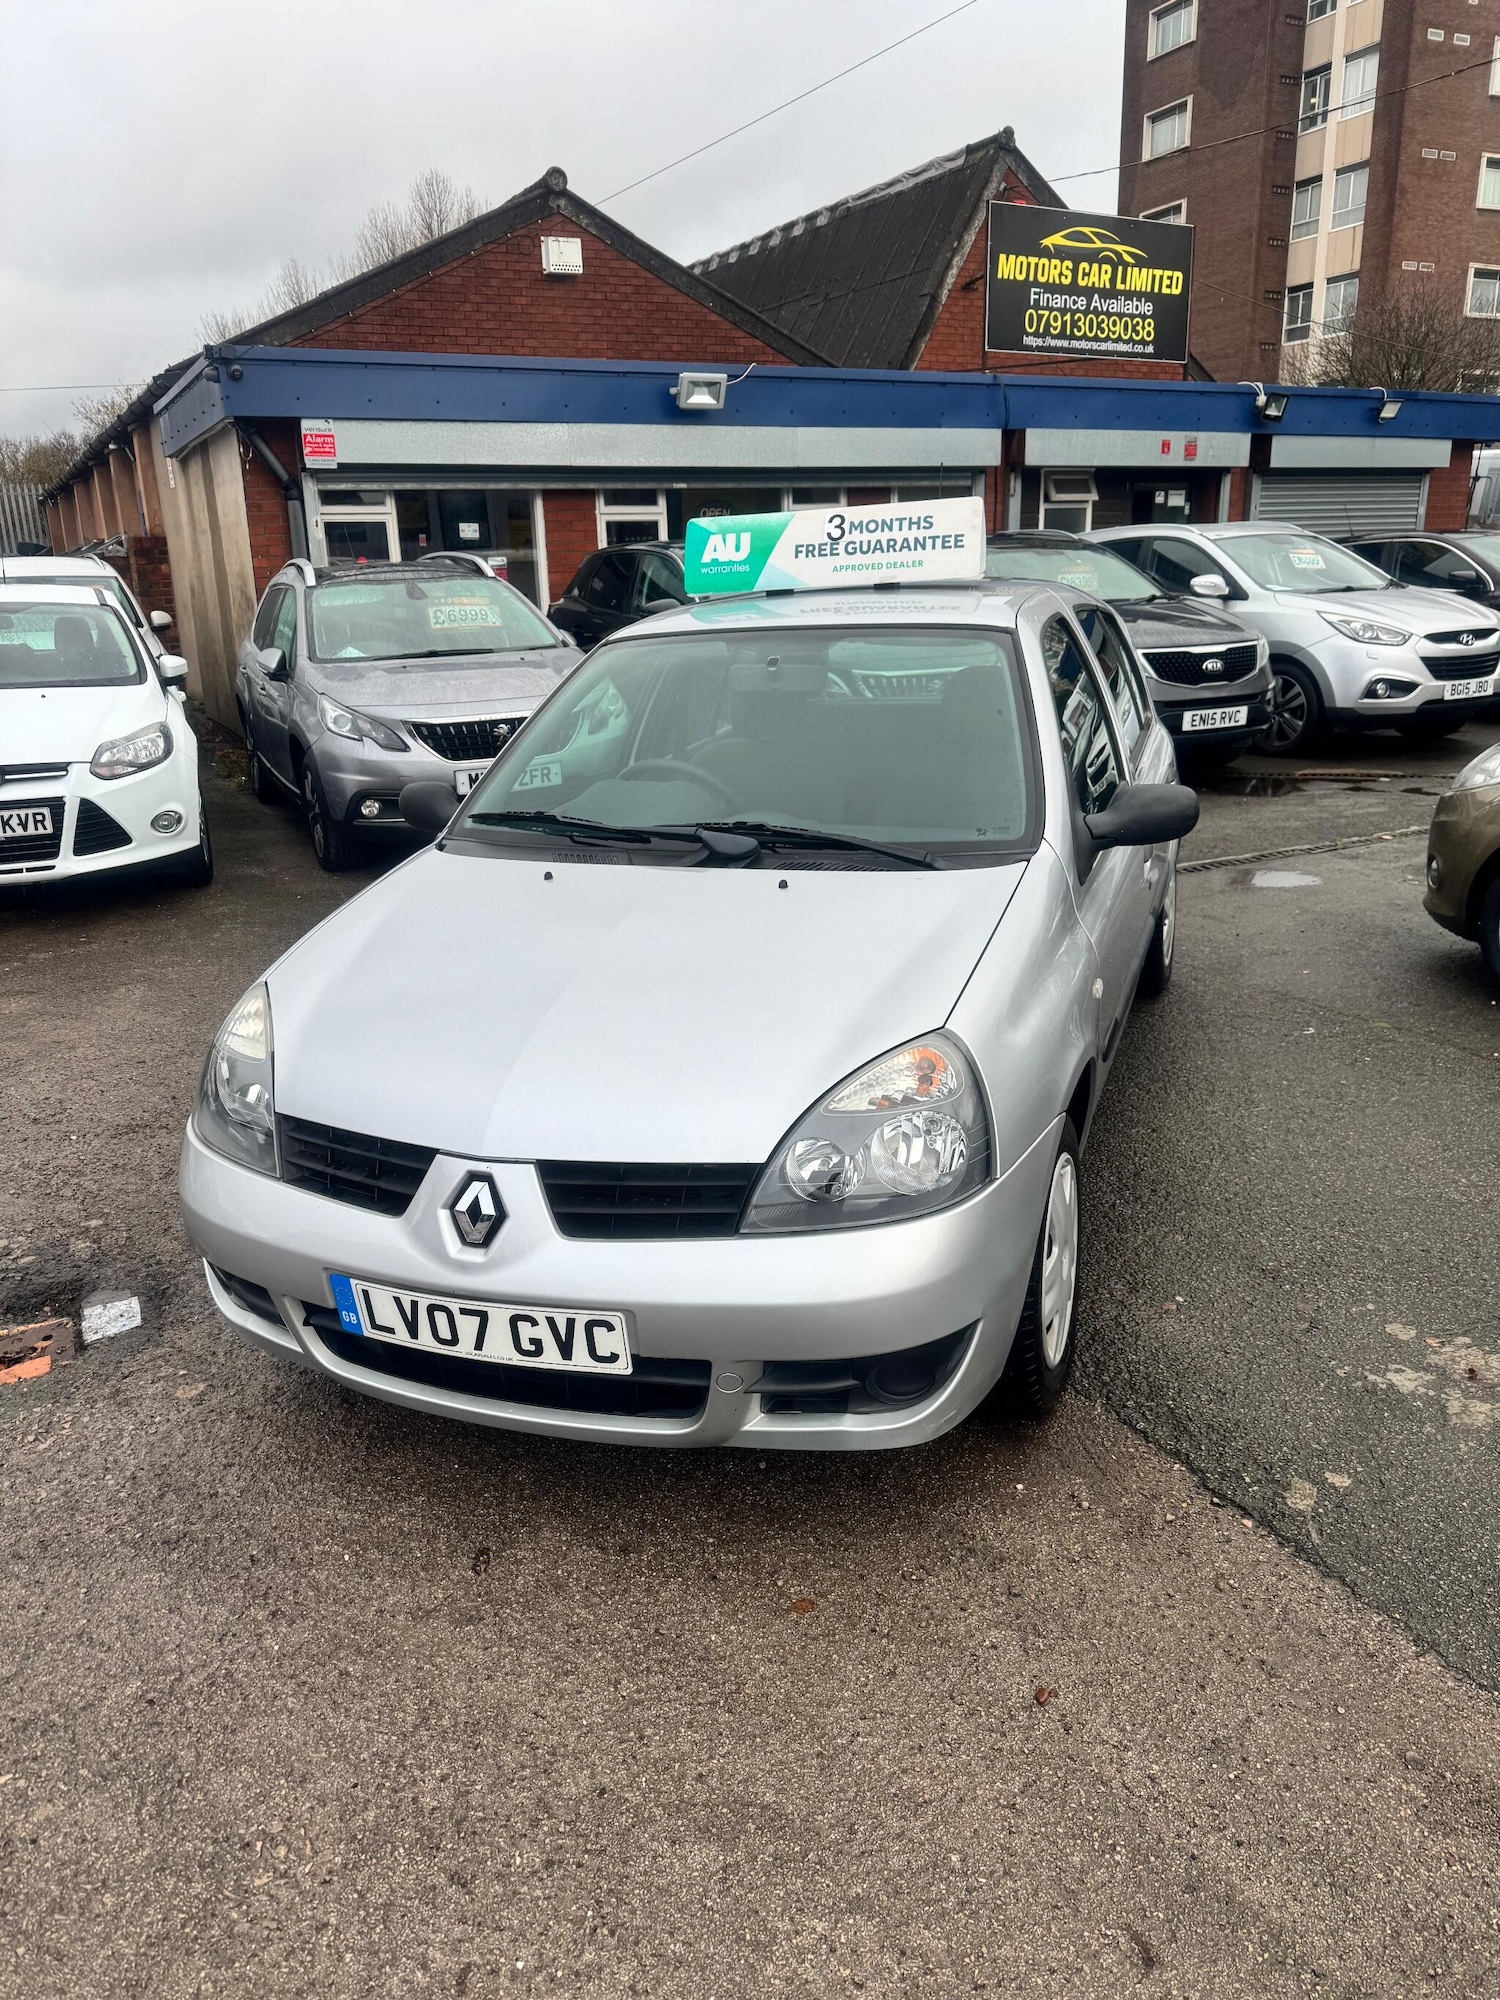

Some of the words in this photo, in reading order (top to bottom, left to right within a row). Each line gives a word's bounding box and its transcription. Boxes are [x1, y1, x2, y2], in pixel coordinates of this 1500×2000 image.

[997, 254, 1073, 285] MOTORS
[1077, 262, 1112, 288] CAR
[1116, 265, 1183, 295] LIMITED
[1030, 287, 1086, 310] Finance
[1090, 293, 1153, 315] Available
[1024, 308, 1155, 341] 07913039038
[1023, 335, 1154, 353] https://www.motorscarlimited.co.uk
[306, 434, 333, 444] Alarm
[826, 514, 846, 542] 3
[848, 515, 934, 535] MONTHS
[700, 532, 751, 563] AU
[794, 541, 840, 559] FREE
[844, 534, 965, 556] GUARANTEE
[700, 563, 750, 574] warranties
[832, 561, 883, 573] APPROVED
[886, 560, 924, 569] DEALER
[432, 608, 489, 626] £6999
[1206, 662, 1222, 672] KIA
[1451, 682, 1471, 697] BG15
[1191, 712, 1218, 728] EN15
[1220, 709, 1241, 725] RVC
[518, 766, 552, 787] ZFR
[0, 812, 48, 834] KVR
[342, 1310, 358, 1325] GB
[361, 1288, 489, 1351] LV07
[509, 1313, 621, 1364] GVC
